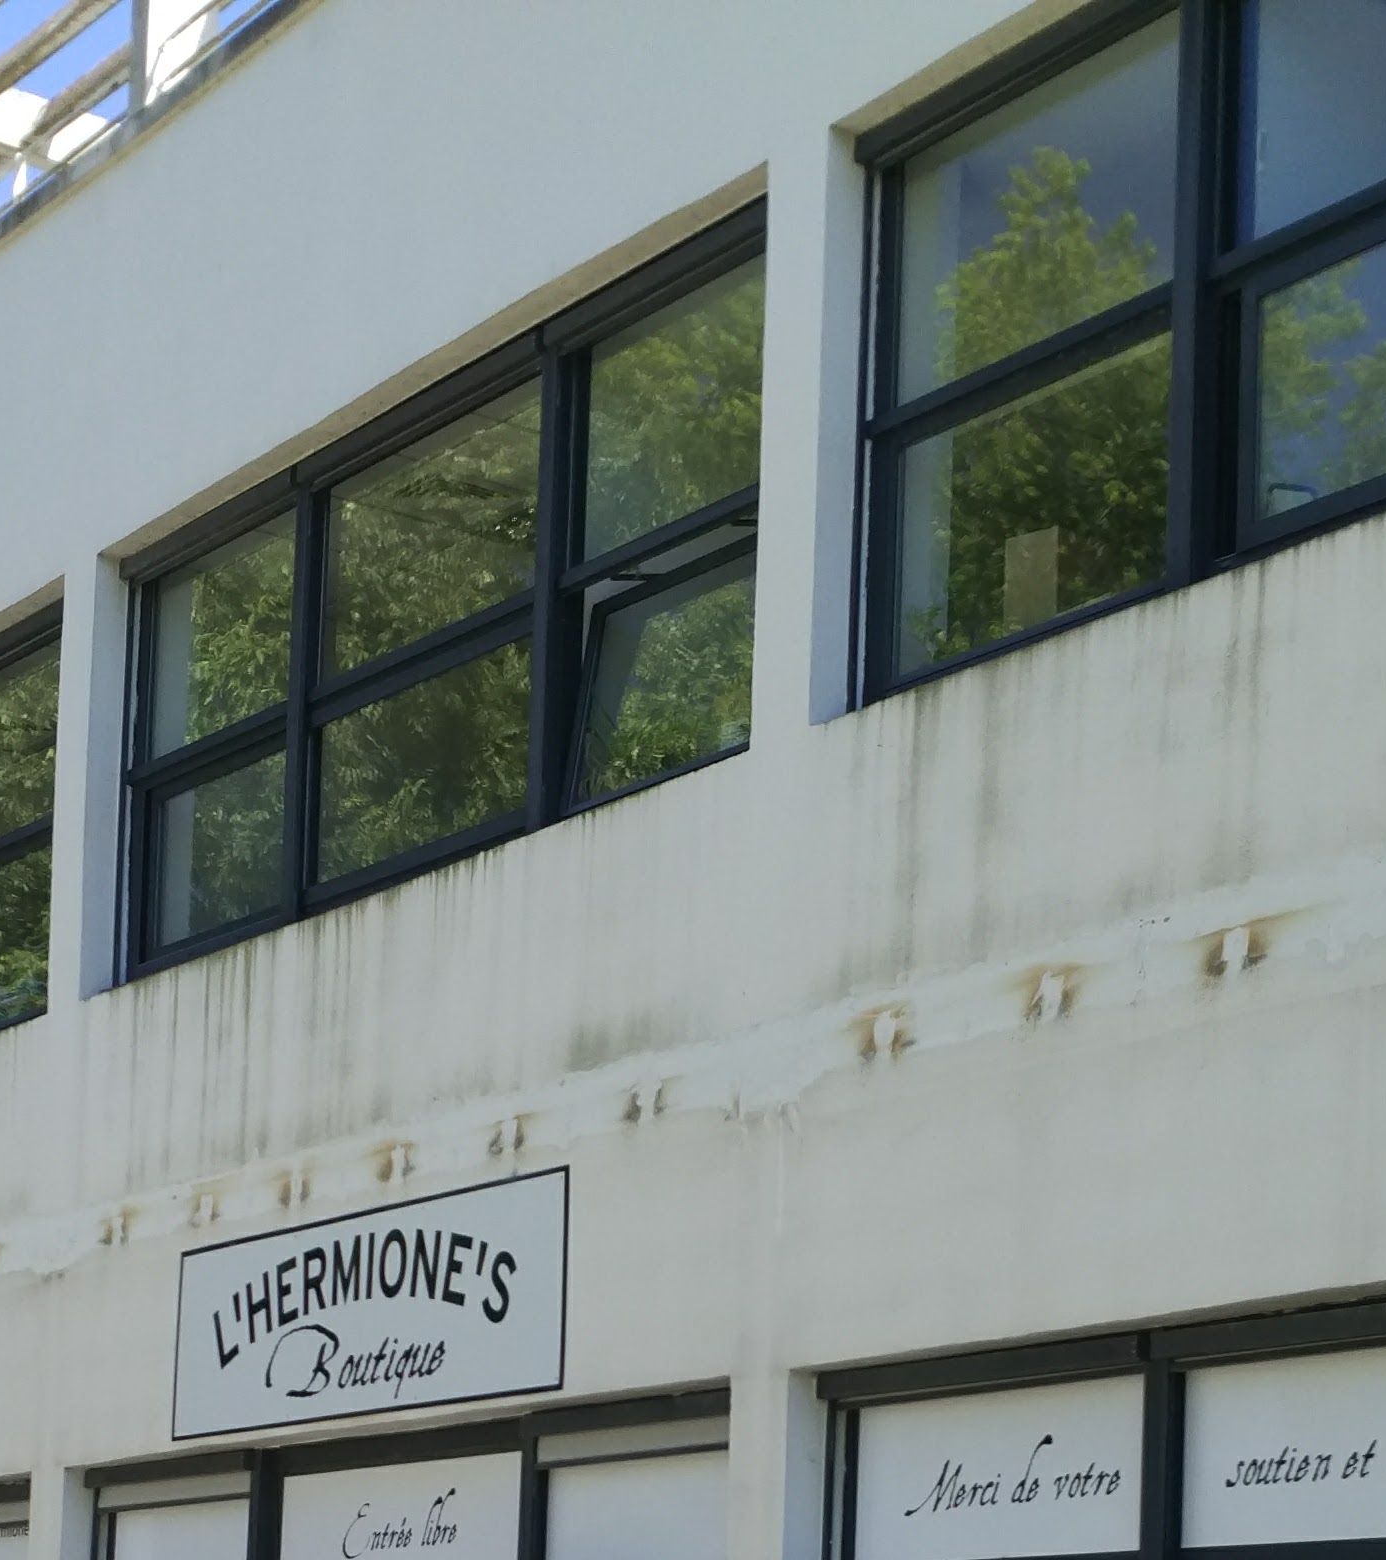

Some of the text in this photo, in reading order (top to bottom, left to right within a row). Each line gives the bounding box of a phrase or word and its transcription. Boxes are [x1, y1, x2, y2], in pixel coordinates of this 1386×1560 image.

[212, 1227, 518, 1370] L'HERMIONE'S
[265, 1323, 446, 1399] Boutique
[904, 1434, 1122, 1516] Merci de votre
[1225, 1445, 1334, 1488] soutien
[1341, 1439, 1378, 1480] et
[342, 1487, 457, 1559] Entrée libre
